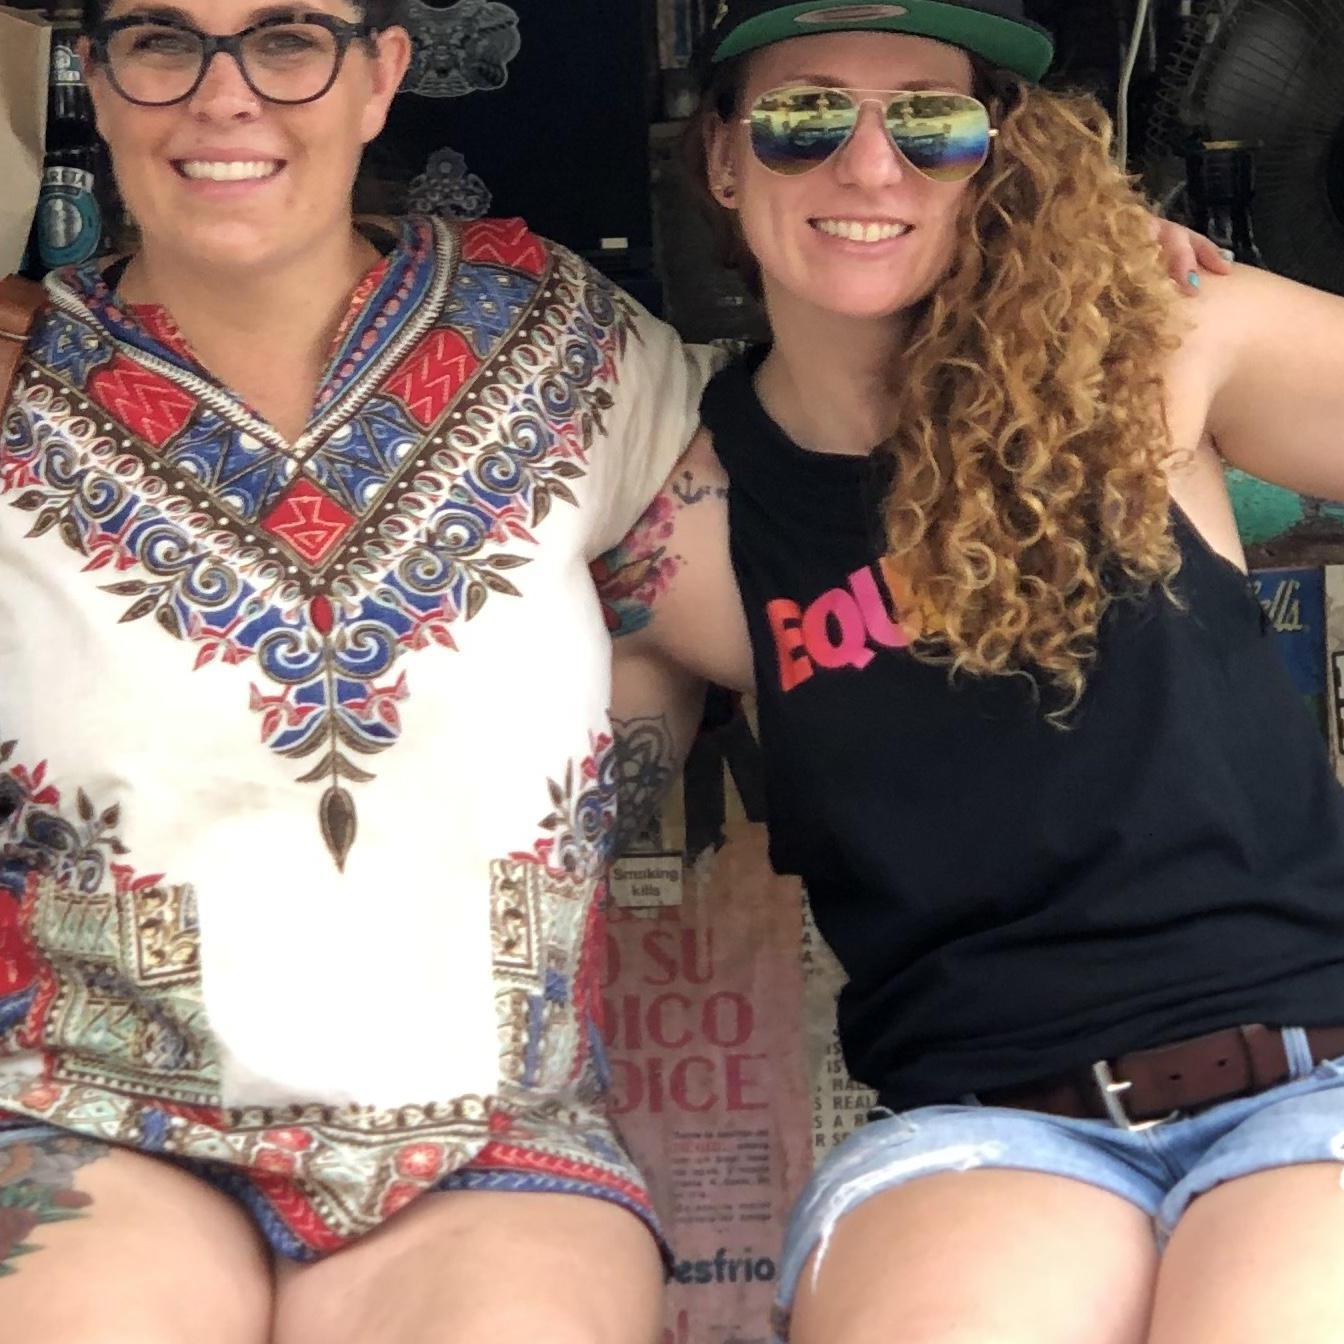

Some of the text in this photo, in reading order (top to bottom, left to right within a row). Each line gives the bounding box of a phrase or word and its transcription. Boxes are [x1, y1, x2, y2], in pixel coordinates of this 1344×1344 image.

[613, 868, 680, 882] Smoking
[631, 883, 661, 898] kills
[642, 928, 715, 986] SU
